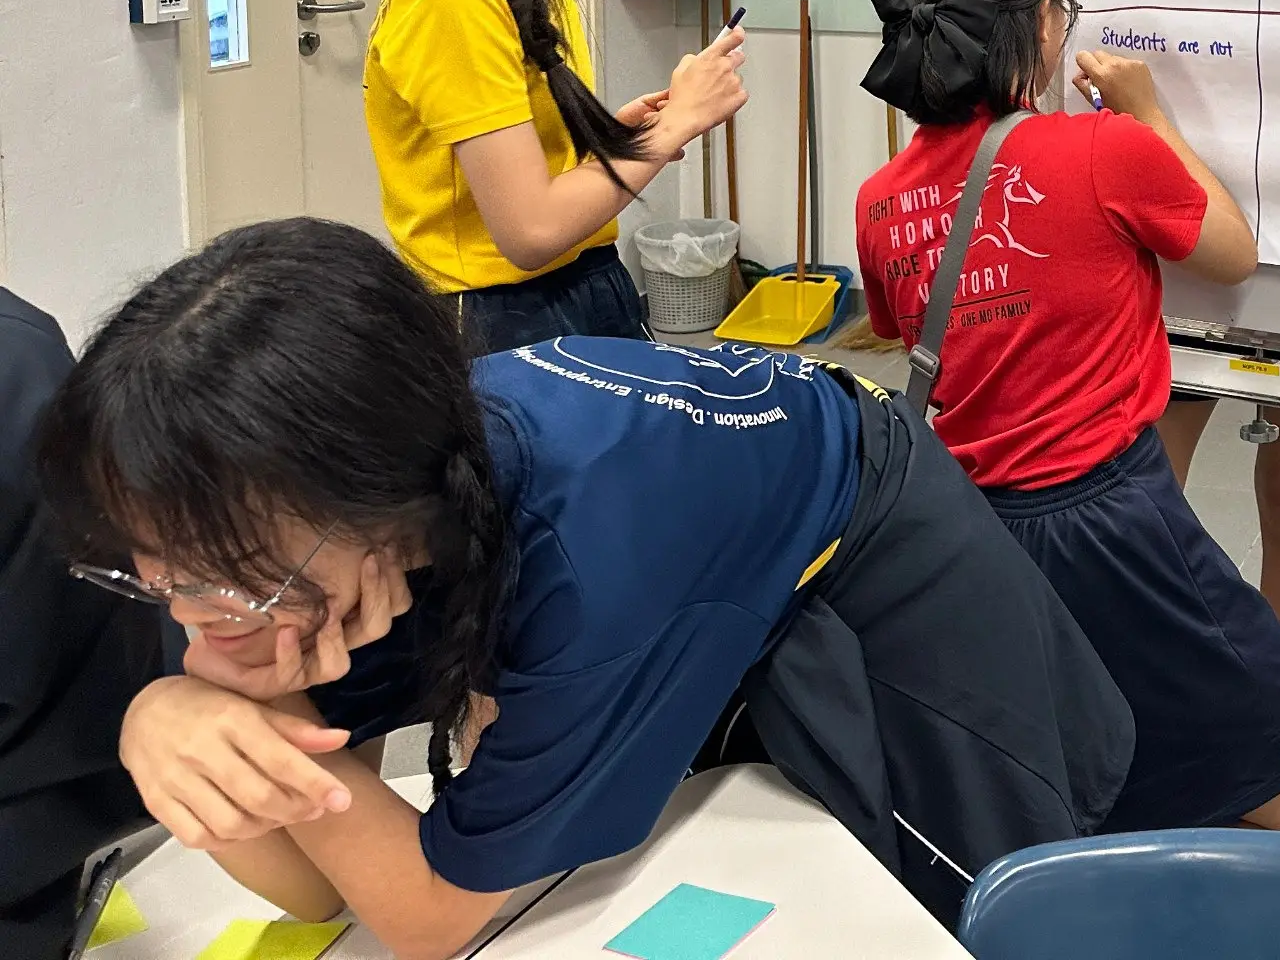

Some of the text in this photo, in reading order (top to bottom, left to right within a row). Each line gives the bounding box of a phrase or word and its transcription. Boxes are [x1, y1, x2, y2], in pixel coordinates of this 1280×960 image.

[1102, 27, 1233, 57] Students are not
[868, 184, 941, 226] FIGHT WITH
[889, 206, 984, 249] HONOR
[885, 253, 921, 282] RACE
[918, 263, 1009, 304] VTORY
[996, 299, 1031, 320] FAMILY
[645, 392, 788, 430] Innovation Design
